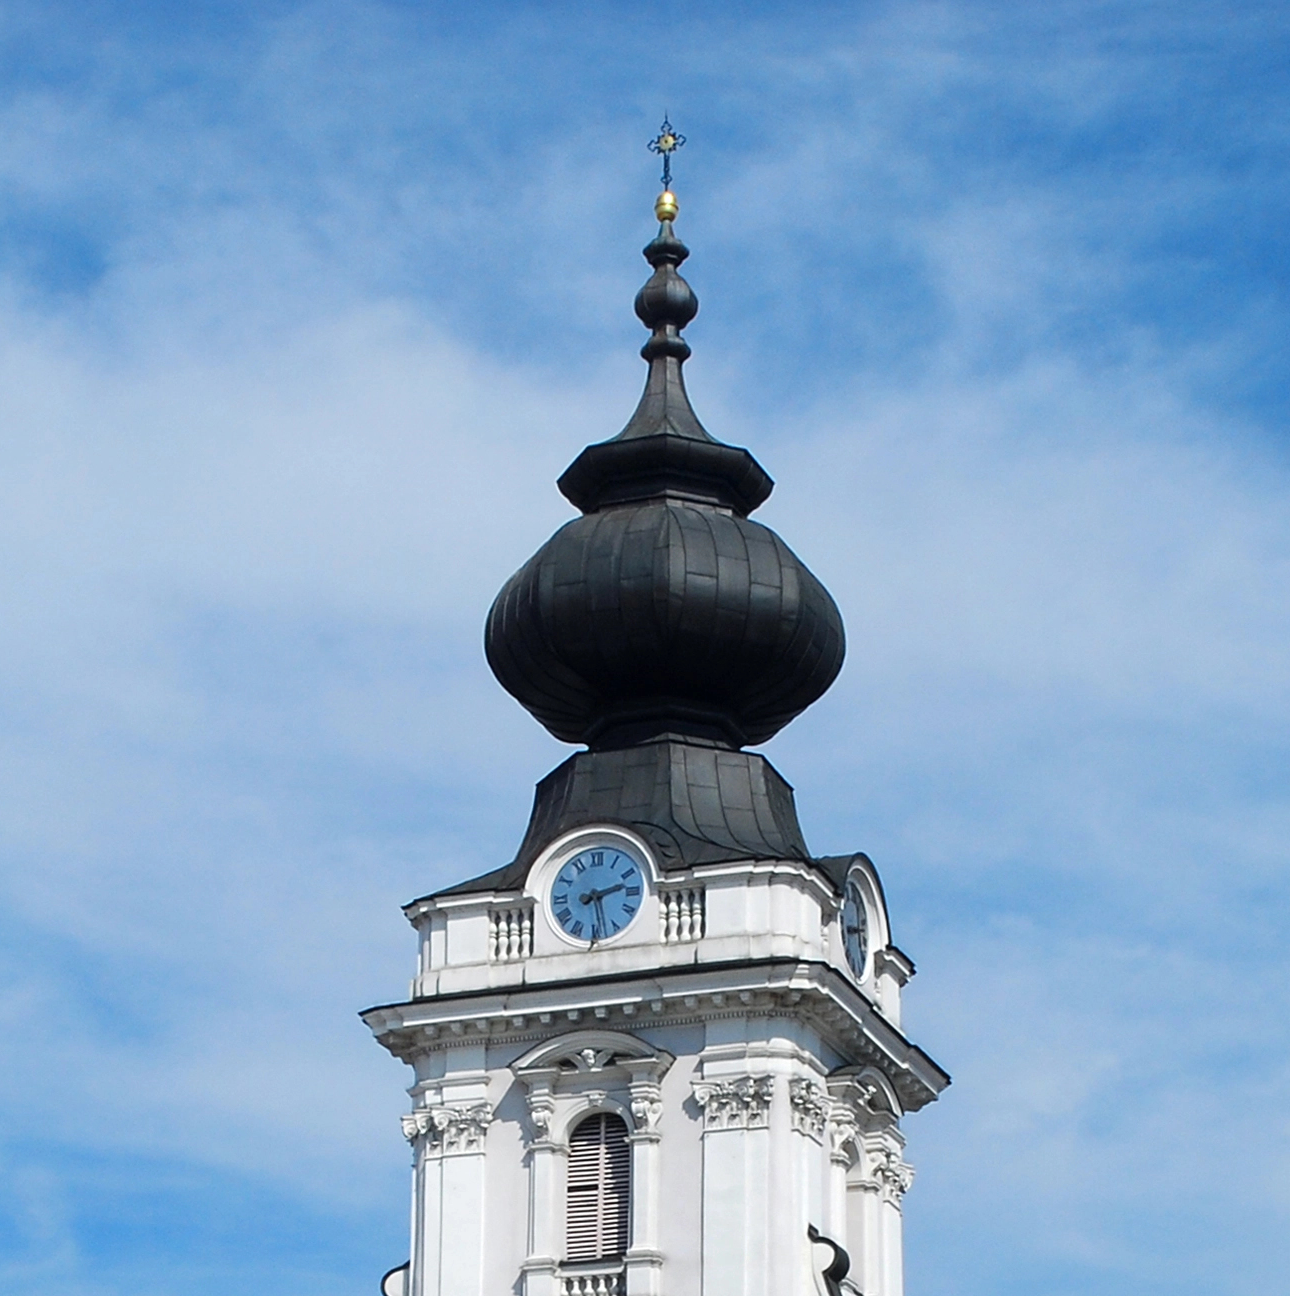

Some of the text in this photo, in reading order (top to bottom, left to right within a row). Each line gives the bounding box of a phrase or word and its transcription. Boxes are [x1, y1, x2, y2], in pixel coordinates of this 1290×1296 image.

[590, 851, 604, 867] XII
[610, 855, 620, 869] I
[571, 858, 587, 875] XI
[621, 867, 636, 880] II
[558, 875, 573, 887] X
[625, 886, 640, 897] III
[553, 893, 568, 905] IX
[555, 907, 573, 927] VIII
[622, 903, 636, 917] IV
[570, 920, 584, 937] VII
[610, 919, 621, 932] V
